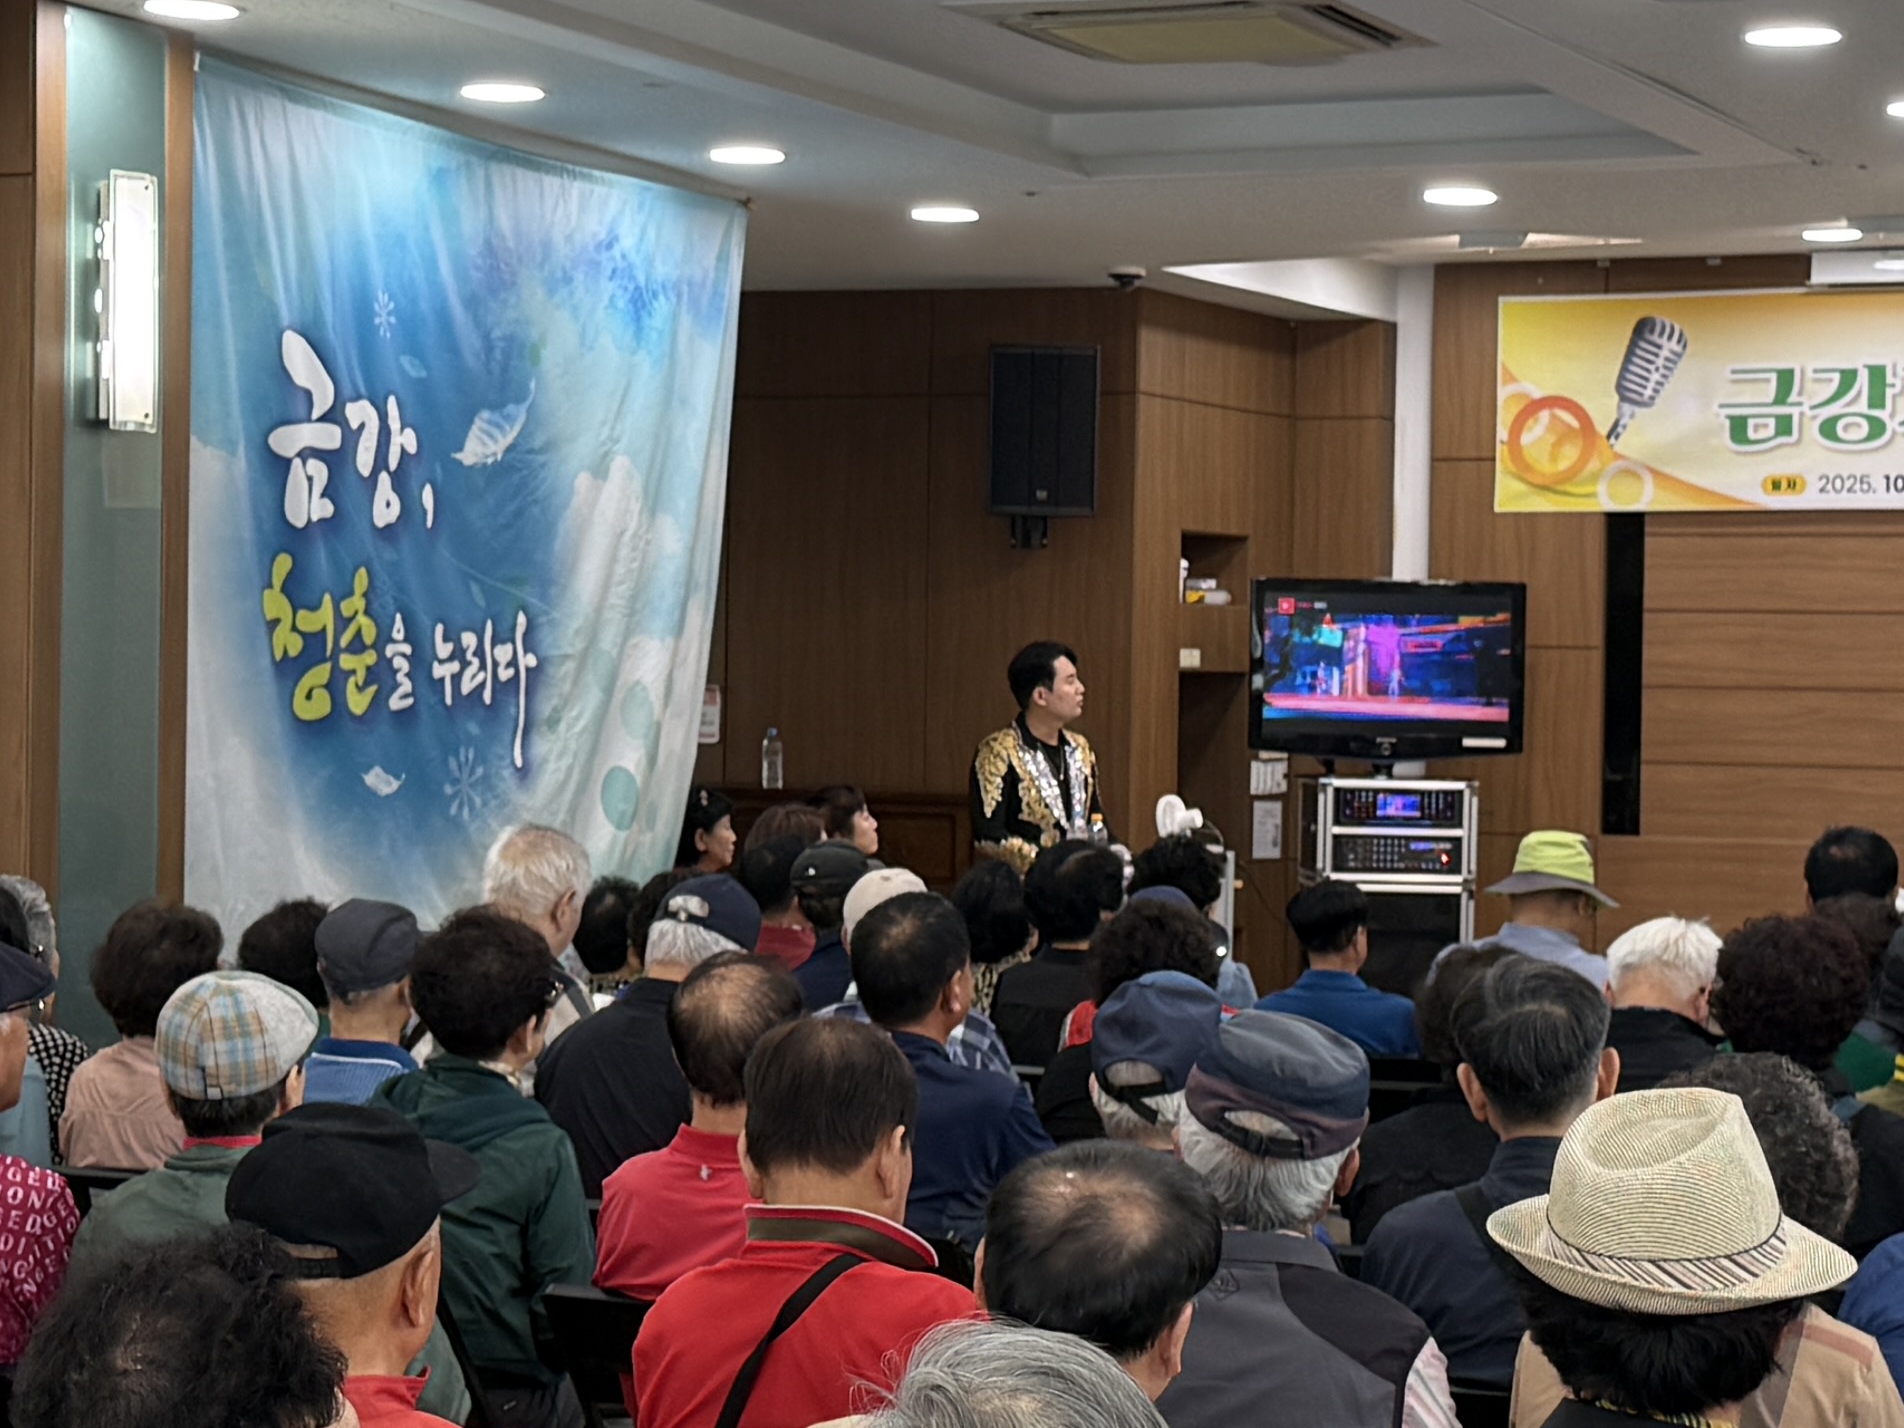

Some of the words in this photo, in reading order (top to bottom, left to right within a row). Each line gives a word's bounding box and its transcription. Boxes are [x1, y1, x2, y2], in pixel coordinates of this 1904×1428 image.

[266, 328, 436, 531] 금강,
[1817, 473, 1877, 495] 2025.
[261, 552, 416, 723] 청춘을
[430, 610, 538, 770] 누리다
